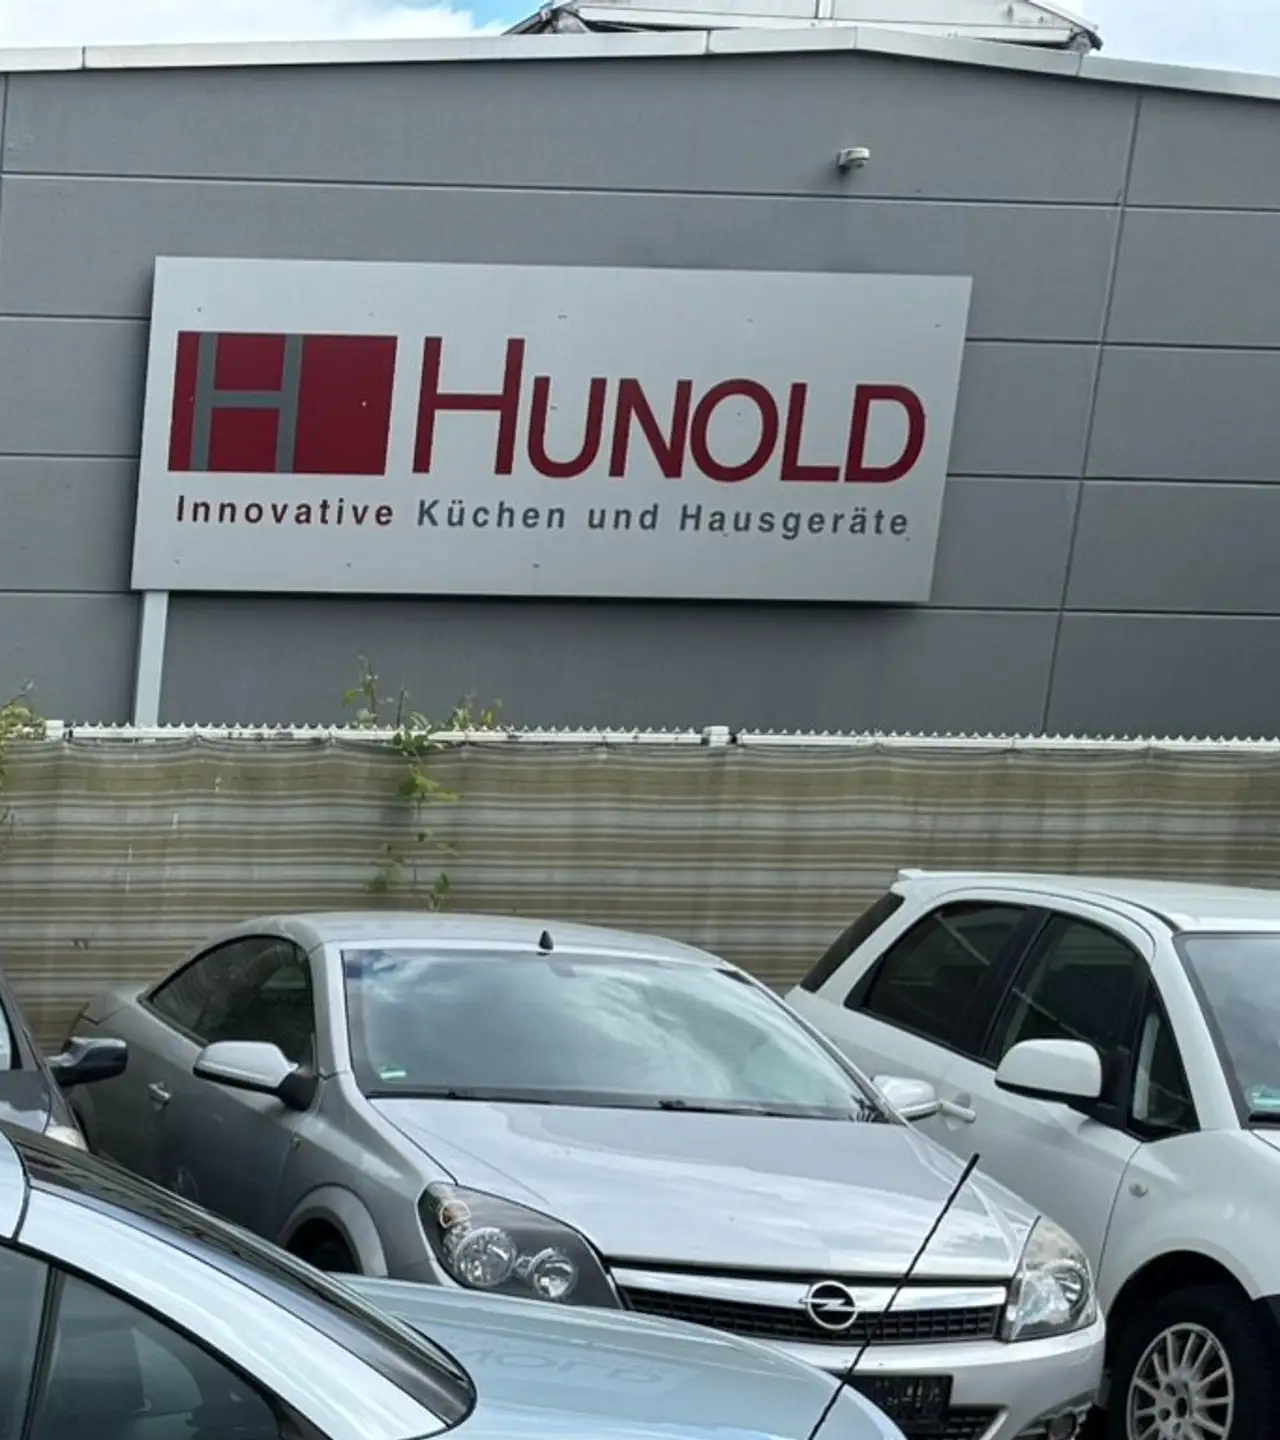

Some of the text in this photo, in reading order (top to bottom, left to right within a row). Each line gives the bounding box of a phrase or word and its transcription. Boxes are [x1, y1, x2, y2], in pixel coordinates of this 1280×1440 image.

[413, 336, 926, 484] HUNOLD
[175, 494, 909, 540] Innovative Küchen und Hausgeräte
